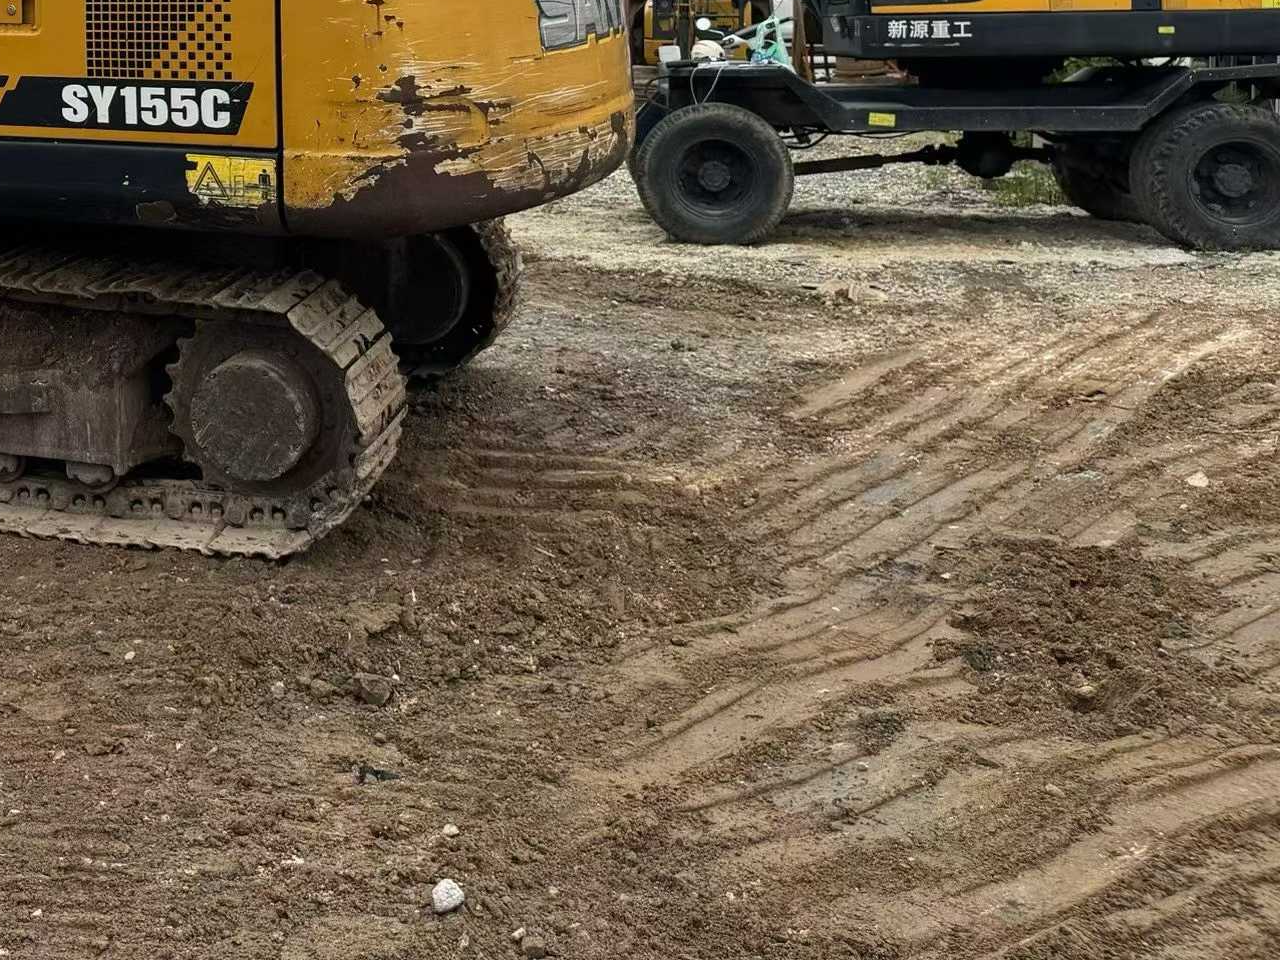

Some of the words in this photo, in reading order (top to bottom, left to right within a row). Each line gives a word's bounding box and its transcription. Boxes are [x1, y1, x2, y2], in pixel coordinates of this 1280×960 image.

[888, 20, 972, 39] 新源重工
[61, 84, 231, 129] SY155C
